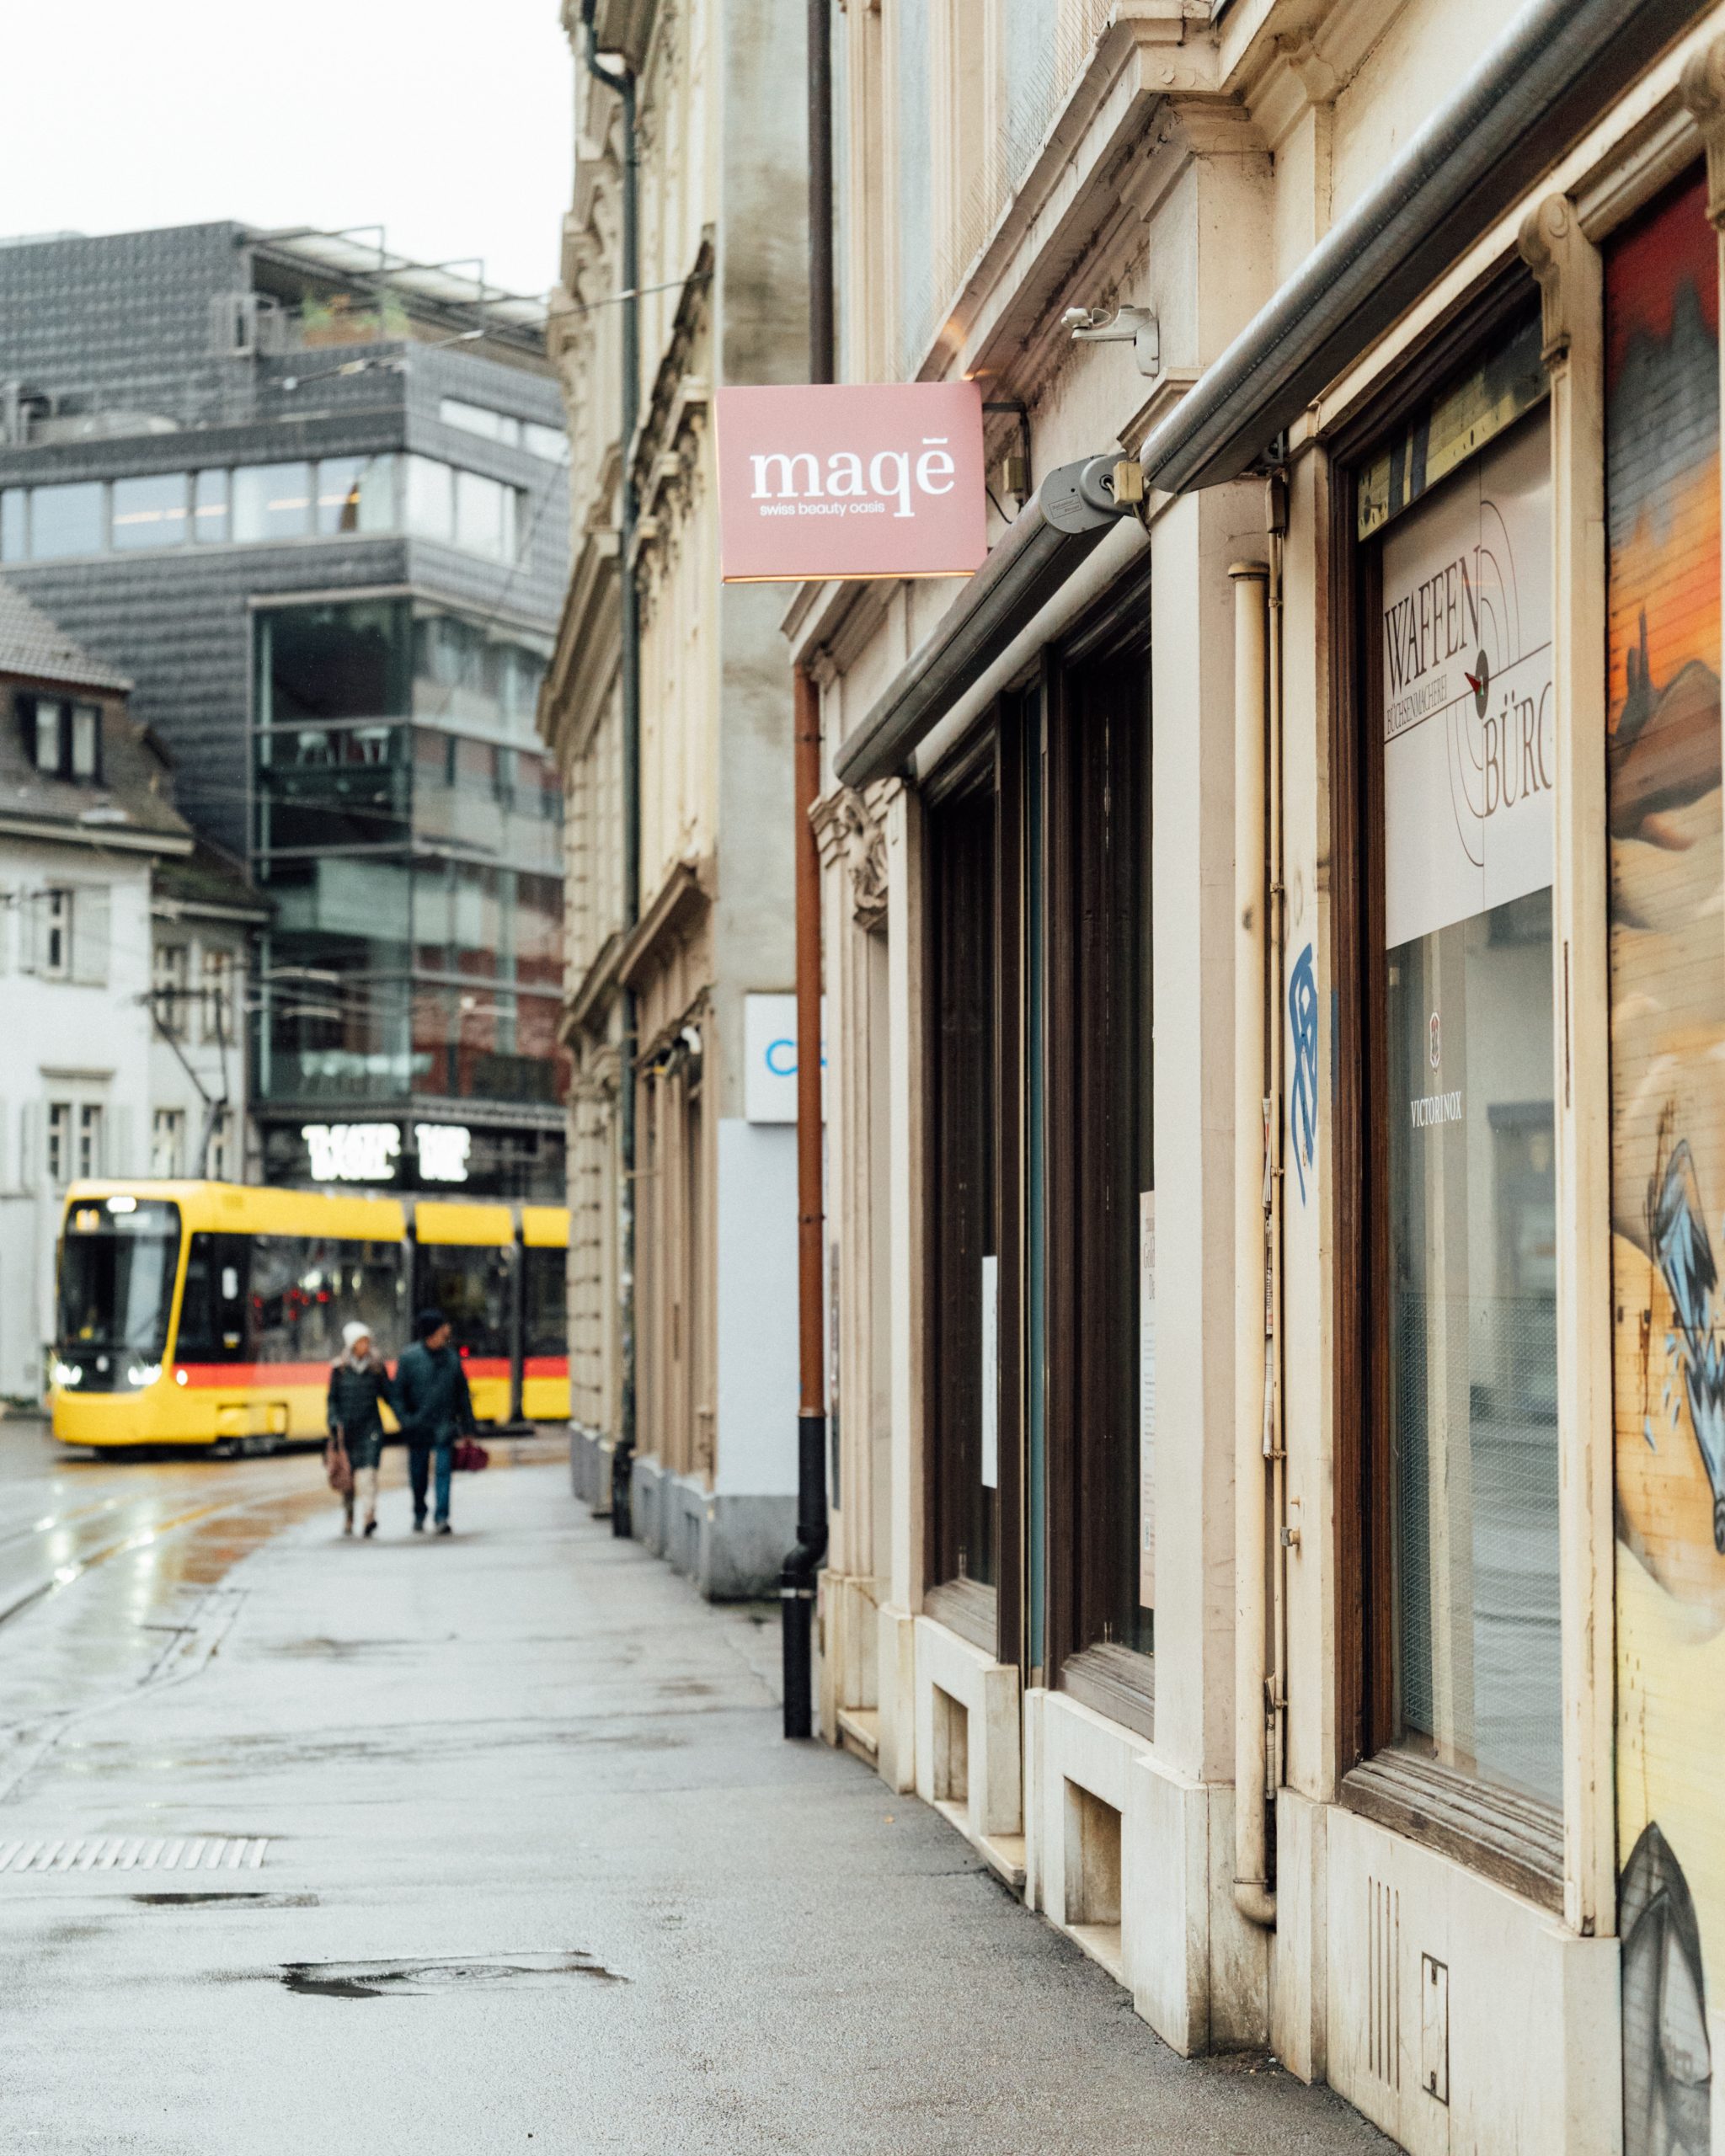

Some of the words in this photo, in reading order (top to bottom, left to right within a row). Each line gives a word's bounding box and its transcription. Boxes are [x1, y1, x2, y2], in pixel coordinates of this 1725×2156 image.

[749, 437, 955, 518] maqē
[760, 503, 796, 516] swiss
[798, 501, 846, 517] beauty
[849, 500, 885, 514] oasis
[1384, 544, 1481, 700] WAFFEN
[1386, 674, 1448, 735] BÜCHSENMACHEREI
[1410, 1091, 1462, 1129] VICTORINOX
